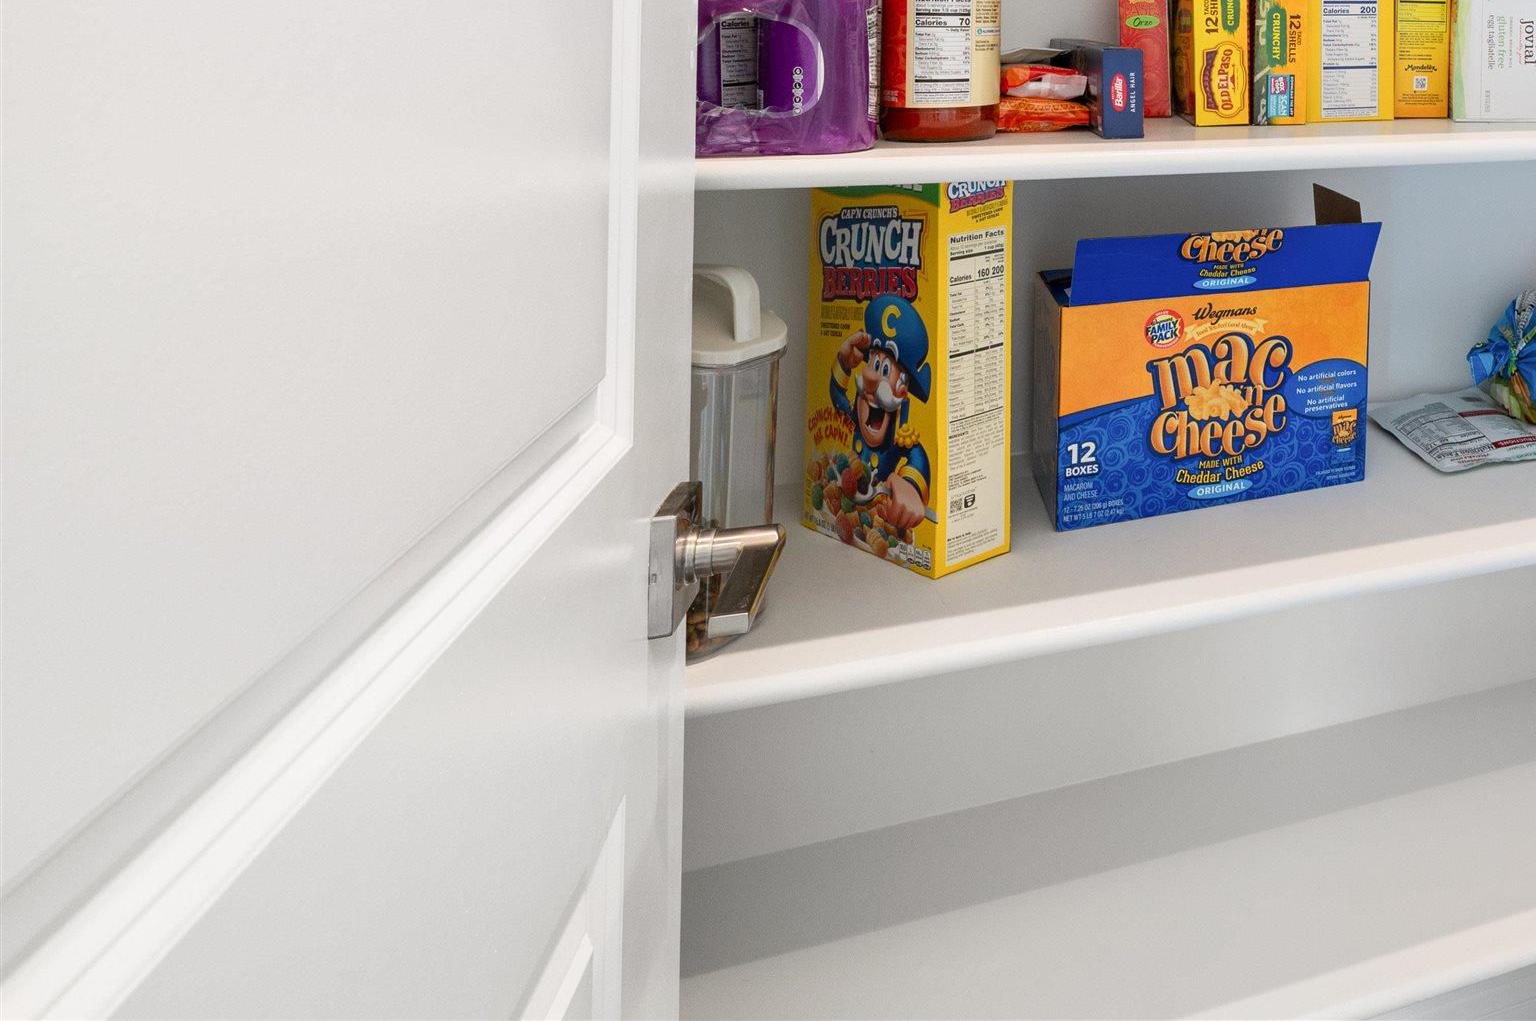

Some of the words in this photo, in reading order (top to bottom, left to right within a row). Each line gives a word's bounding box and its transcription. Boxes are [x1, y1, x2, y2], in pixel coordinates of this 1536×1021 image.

[1360, 6, 1377, 14] 200
[958, 18, 971, 26] 70
[1206, 16, 1219, 35] 12
[1289, 14, 1301, 30] 12
[1272, 13, 1280, 60] CRUNCHY
[1497, 16, 1507, 47] gluten
[1288, 30, 1296, 63] SHELLS
[1497, 49, 1507, 69] free
[841, 207, 861, 220] CAP'N
[862, 206, 898, 219] CRUNCH'S
[820, 217, 923, 268] CRUNCH
[950, 233, 983, 244] Nutrition
[985, 229, 1004, 238] Facts
[1180, 228, 1285, 263] Cheese
[949, 274, 972, 283] Calories
[977, 267, 990, 278] 160
[991, 265, 1005, 275] 200
[1199, 268, 1228, 278] Cheddar
[1229, 266, 1257, 276] Cheese
[822, 266, 918, 300] BERRIES
[1201, 277, 1250, 288] ORIGINAL
[1192, 302, 1258, 325] Wegmans
[1146, 319, 1179, 335] FAMILY
[1151, 328, 1178, 344] PACK
[1150, 333, 1287, 411] mac
[1297, 374, 1308, 382] No
[1308, 370, 1336, 381] artificial
[1337, 369, 1357, 377] colors
[1296, 387, 1306, 395] No
[1307, 383, 1335, 393] artificial
[1335, 381, 1358, 389] flavors
[1317, 394, 1345, 404] artificial
[1304, 402, 1349, 414] preservatives
[1150, 394, 1287, 461] Cheese
[1067, 441, 1096, 465] 12
[1198, 460, 1220, 469] MADE
[1221, 455, 1243, 467] WITH
[1065, 464, 1099, 477] BOXES
[1175, 469, 1220, 484] Cheddar
[1224, 460, 1264, 480] Cheese
[1064, 481, 1094, 492] MACARONI
[1196, 482, 1246, 496] ORIGINAL
[1063, 493, 1076, 501] AND
[1076, 489, 1098, 500] CHEESE
